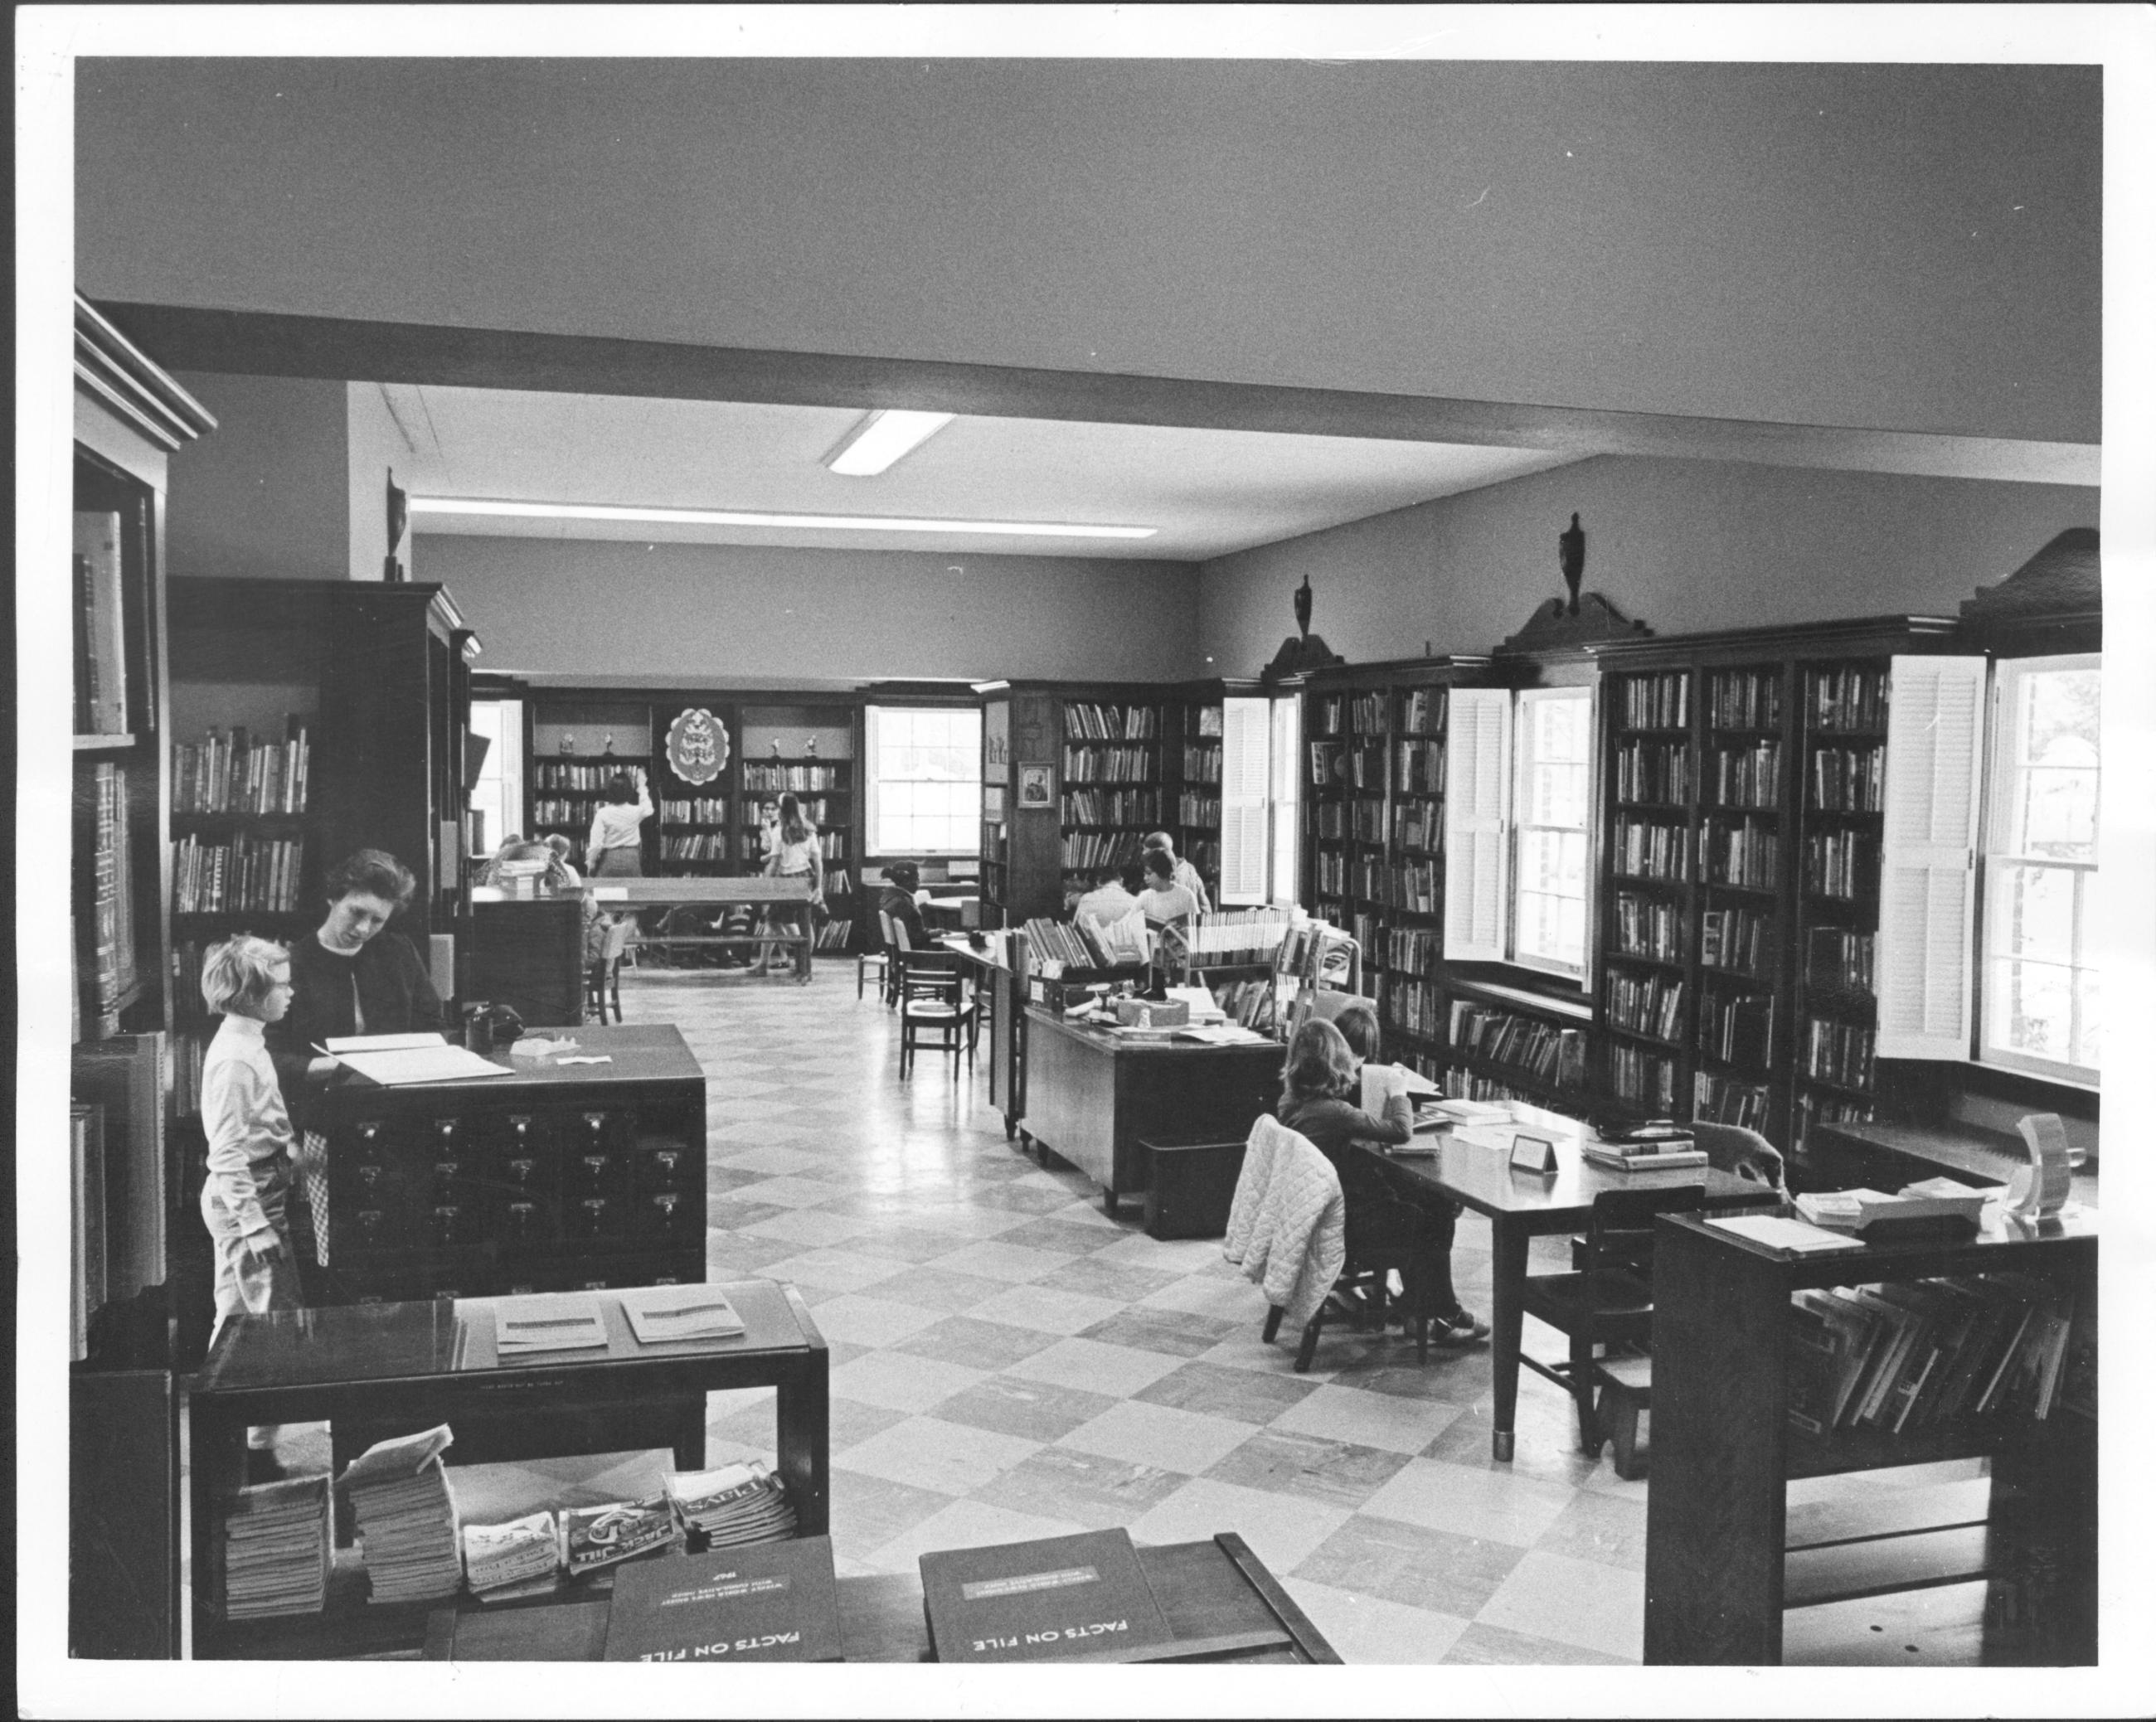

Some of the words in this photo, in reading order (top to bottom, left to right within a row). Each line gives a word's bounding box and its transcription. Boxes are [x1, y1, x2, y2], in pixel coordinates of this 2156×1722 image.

[1065, 1619, 1129, 1639] FACTS
[736, 1631, 800, 1651] FACTS
[972, 1636, 1017, 1652] FILE
[1025, 1631, 1059, 1644] ON
[639, 1648, 687, 1663] FILE
[694, 1642, 729, 1657] ON
